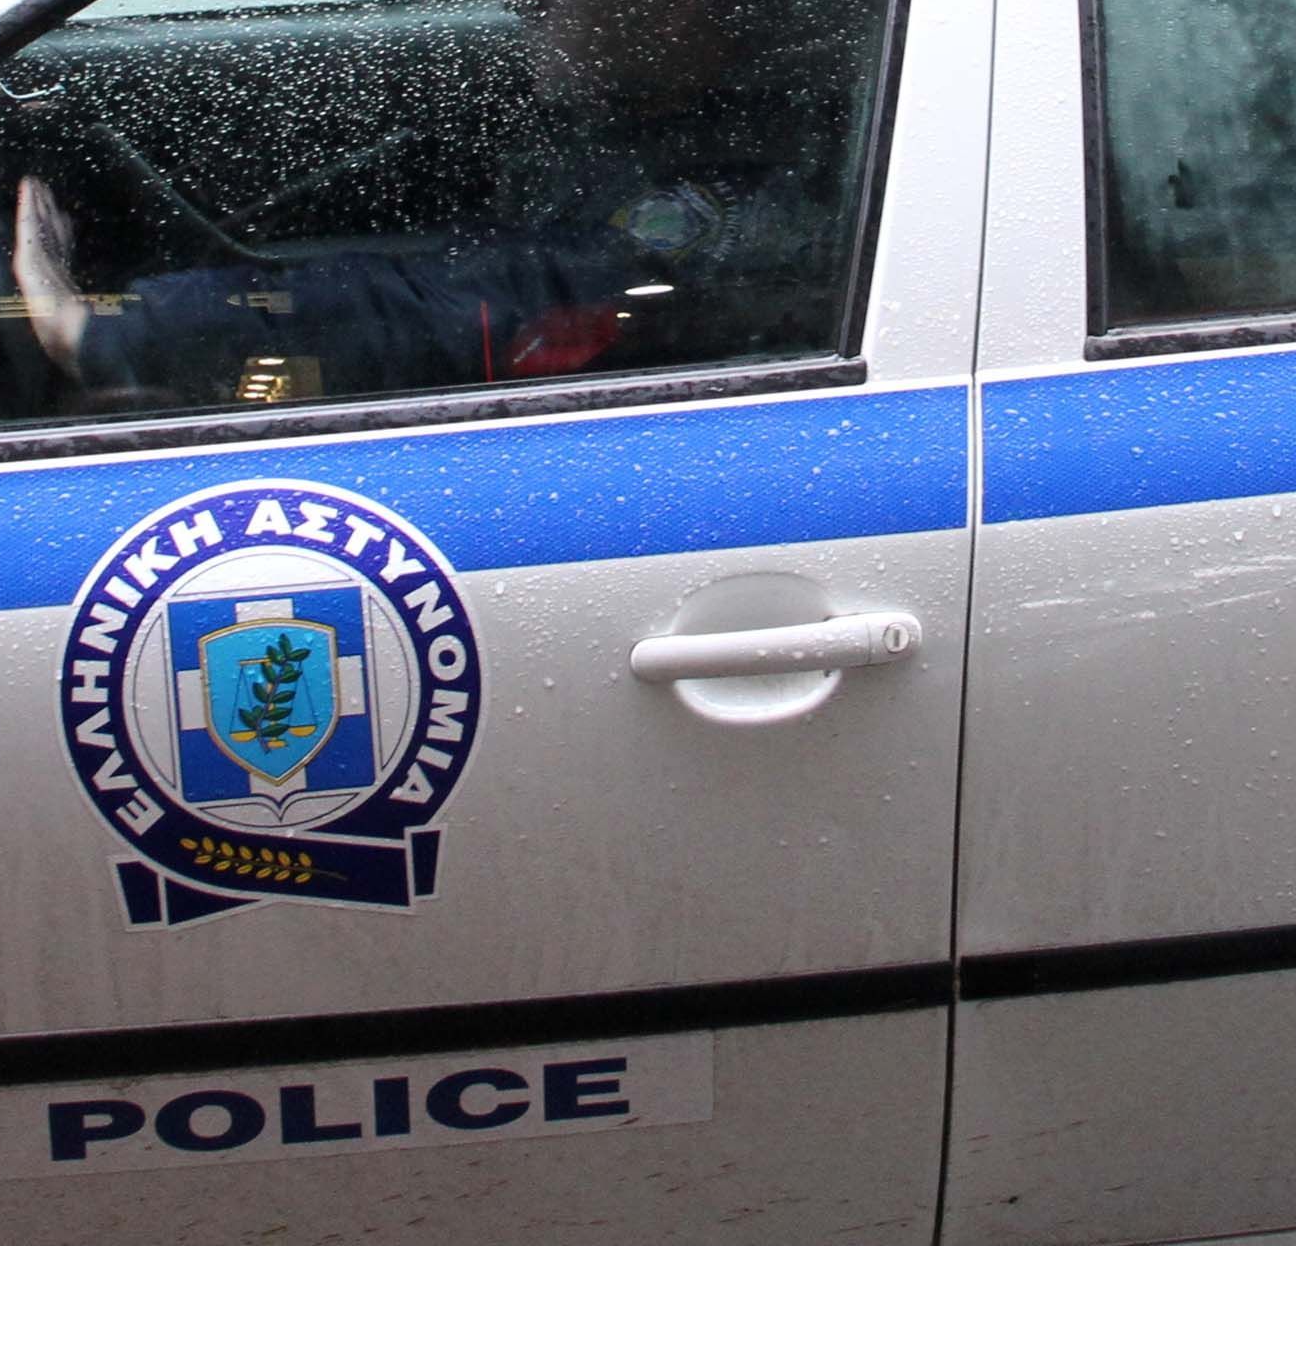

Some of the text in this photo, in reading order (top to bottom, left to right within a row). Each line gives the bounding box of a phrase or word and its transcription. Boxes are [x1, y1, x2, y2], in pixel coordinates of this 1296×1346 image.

[71, 499, 471, 837] ΕΛΛΗΝΙΚΗ ΑΣΤΥΝΟΜΙΑ
[47, 1056, 631, 1162] POLICE
